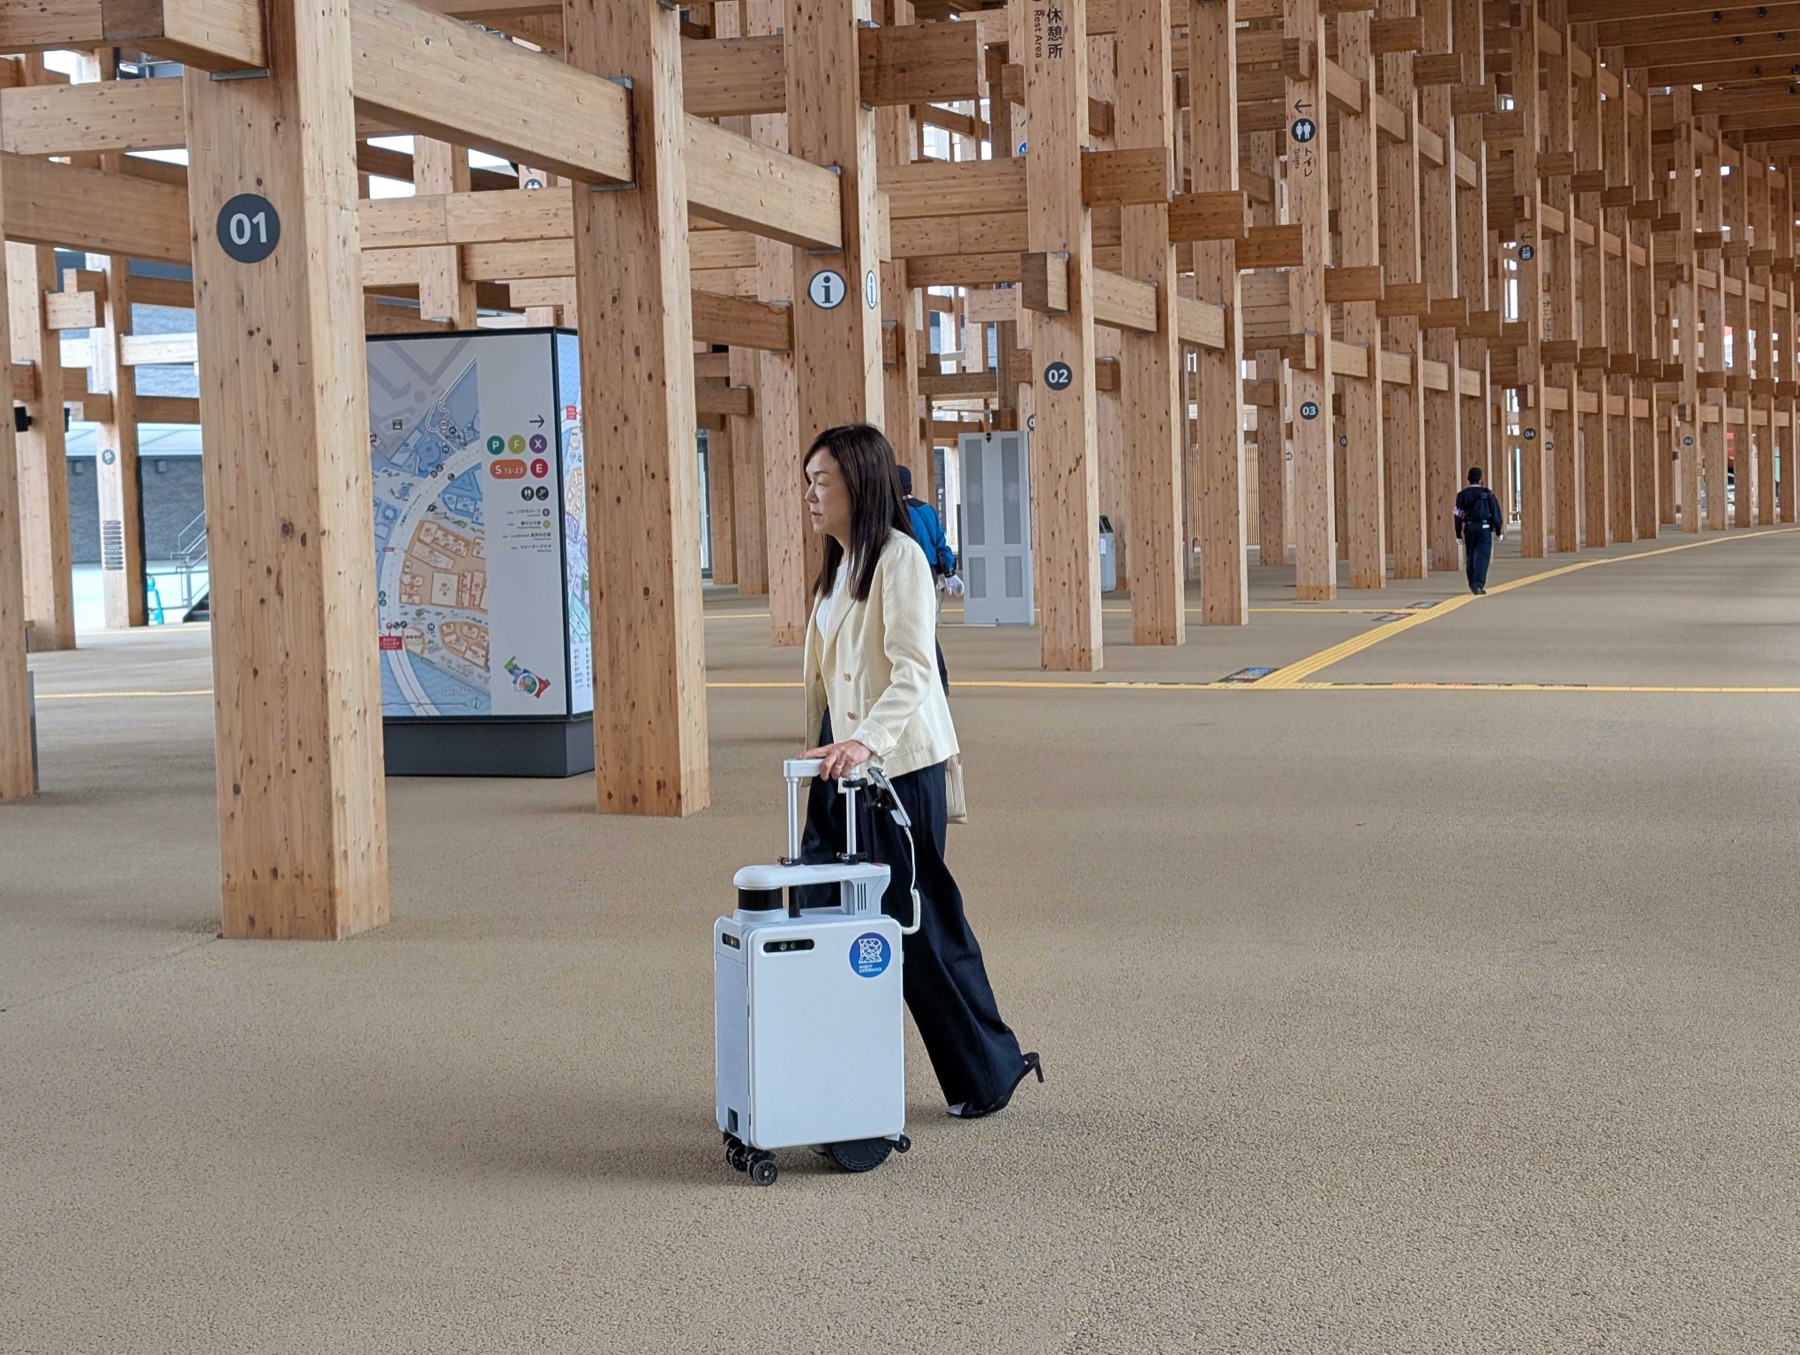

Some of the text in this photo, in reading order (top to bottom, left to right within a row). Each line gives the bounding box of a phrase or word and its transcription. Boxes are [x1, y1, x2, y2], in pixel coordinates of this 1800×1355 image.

[1034, 10, 1042, 58] Rest Area
[1046, 8, 1063, 59] 休憩所
[1304, 147, 1312, 177] トイレ
[229, 211, 268, 246] 01
[1048, 369, 1069, 384] 02
[1302, 406, 1317, 416] 03
[492, 439, 542, 450] P F X
[495, 464, 502, 475] S
[535, 463, 543, 474] E
